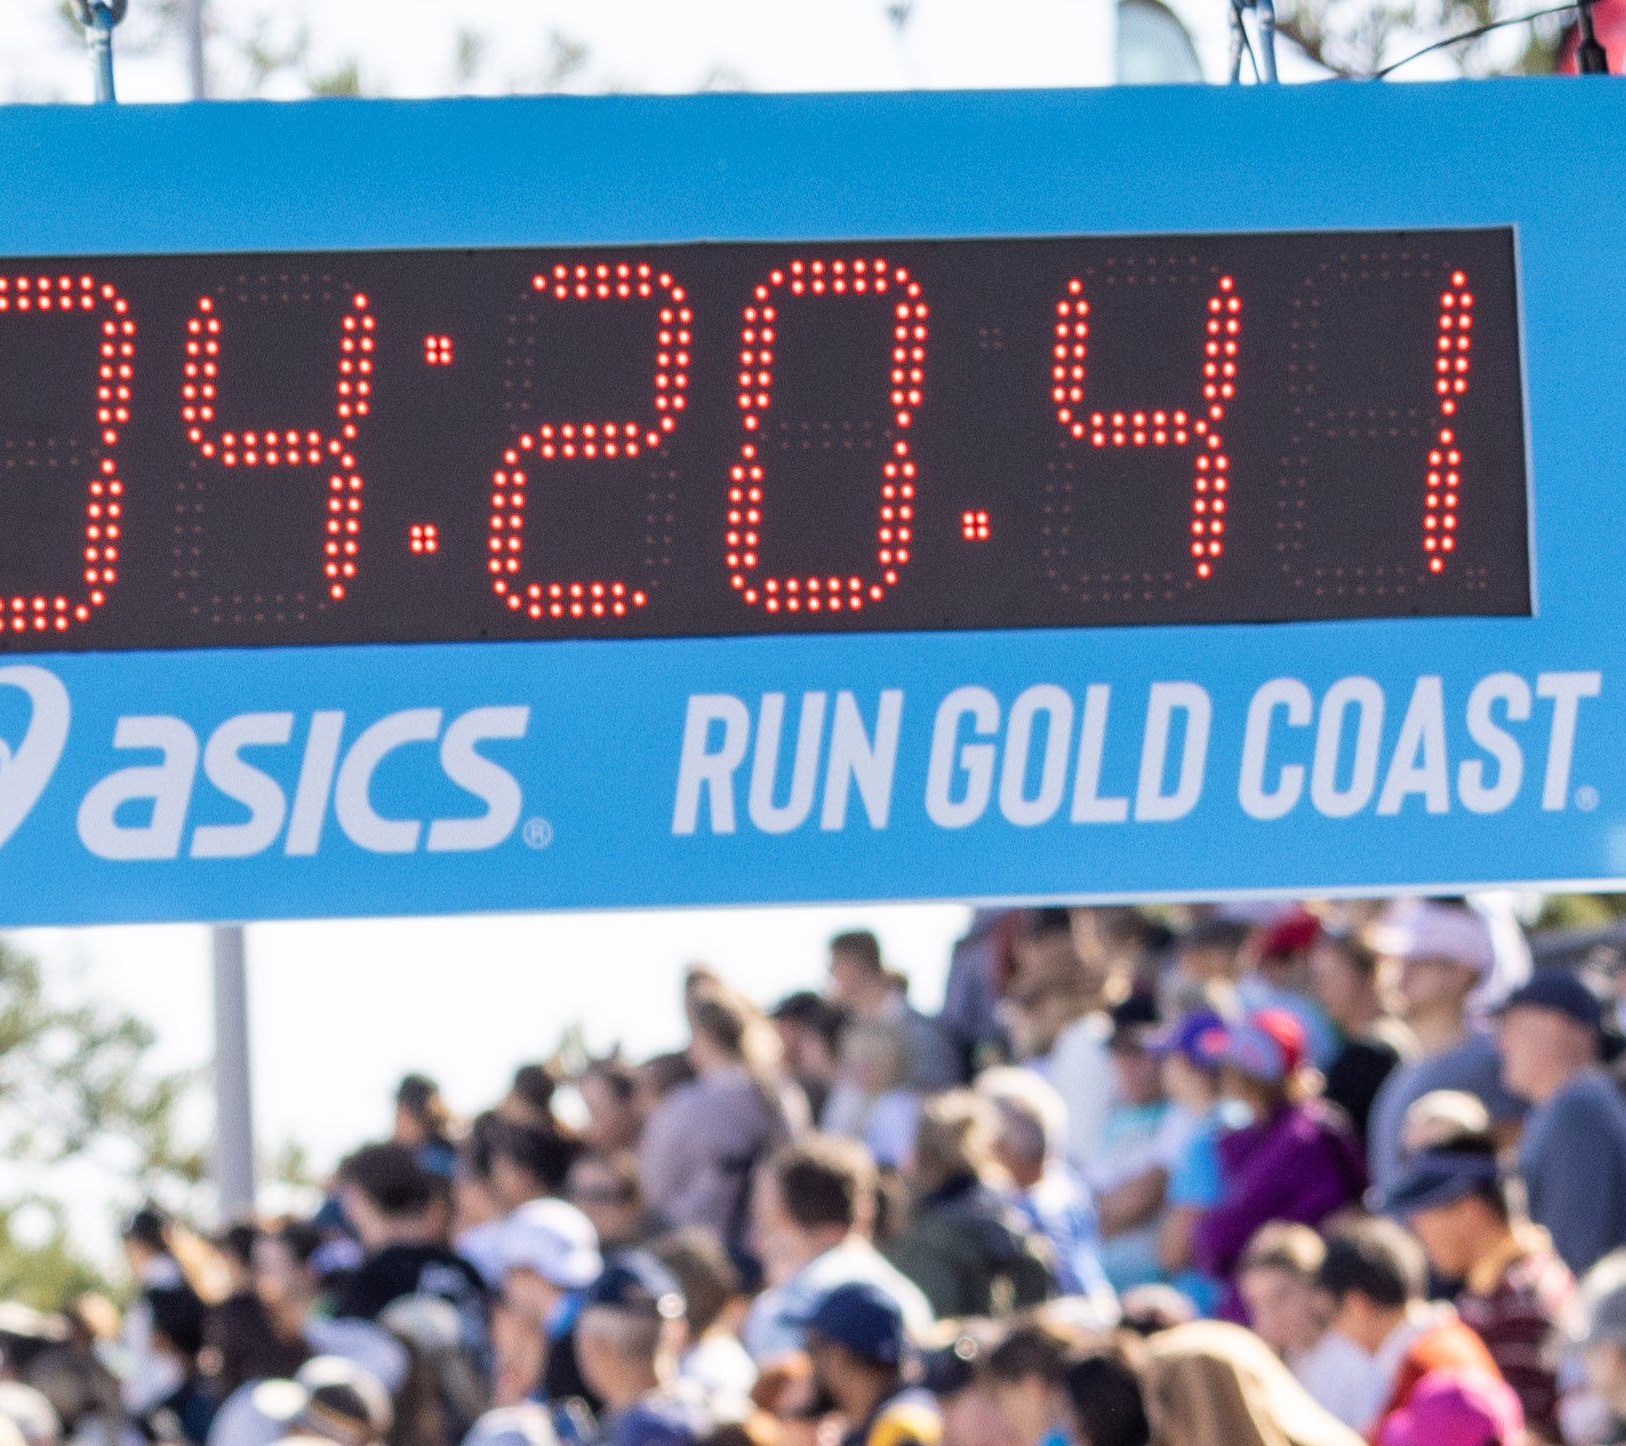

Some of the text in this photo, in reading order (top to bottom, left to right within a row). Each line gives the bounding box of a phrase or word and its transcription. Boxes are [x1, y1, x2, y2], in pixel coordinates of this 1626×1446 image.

[671, 671, 1602, 836] RUN GOLD COAST
